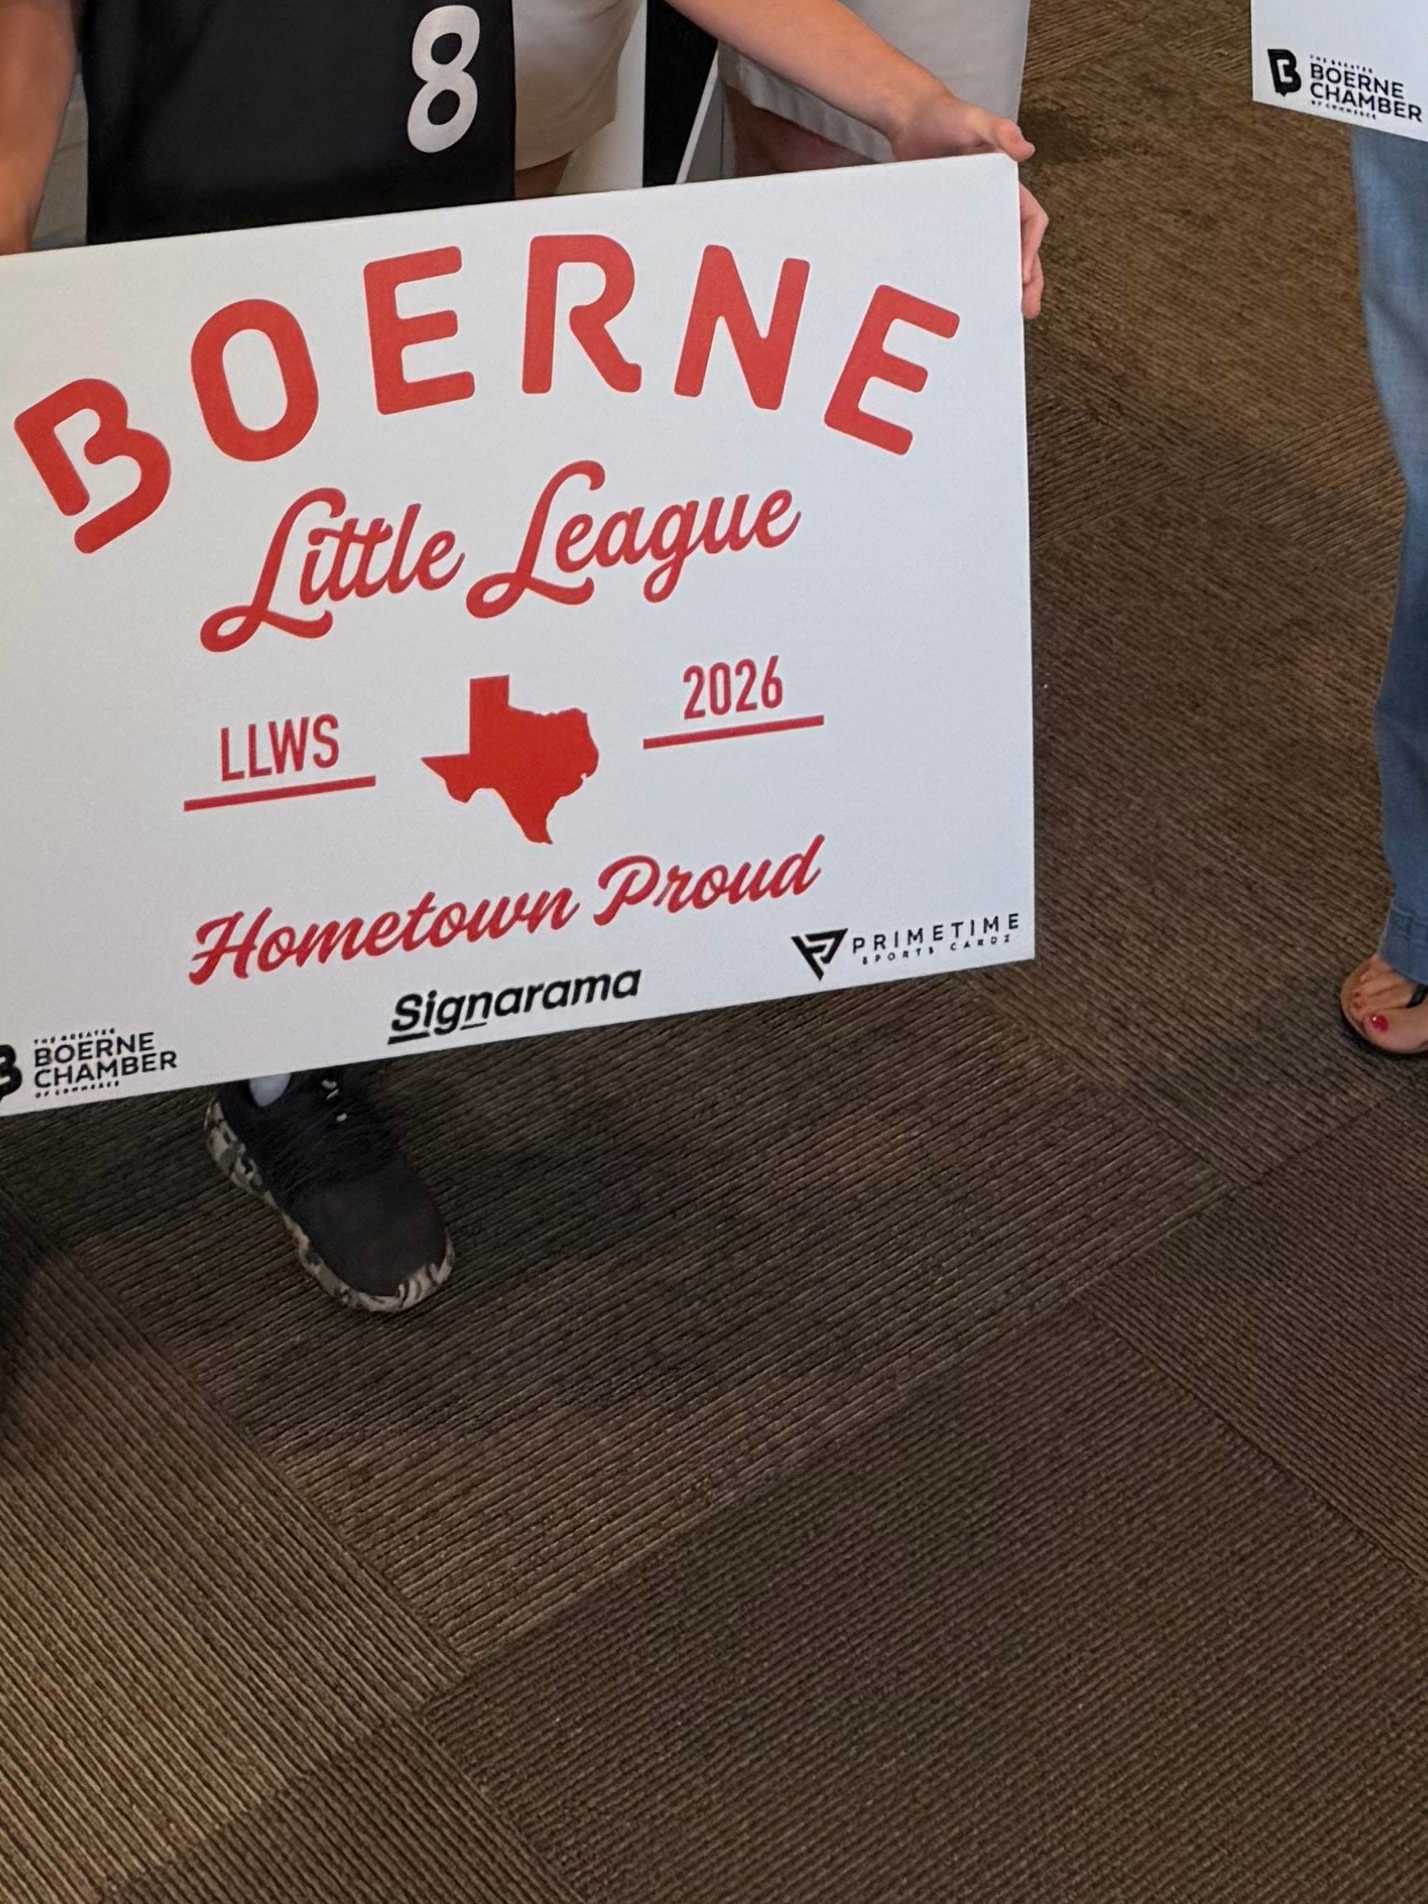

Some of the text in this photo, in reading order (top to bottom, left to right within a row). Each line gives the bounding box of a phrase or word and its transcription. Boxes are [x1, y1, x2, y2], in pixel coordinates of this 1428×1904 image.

[407, 4, 480, 154] 8
[1310, 82, 1422, 123] CHAMBER
[1311, 63, 1404, 100] BOERNE
[14, 235, 959, 554] BOERNE
[200, 461, 796, 653] Little League
[682, 653, 784, 721] 2026
[218, 711, 340, 784] LLWS
[189, 837, 823, 985] Hometown Proud
[853, 913, 1019, 954] PRIMETIME
[862, 947, 934, 965] SPORTS
[390, 969, 642, 1040] Signarama
[34, 1032, 154, 1067] BOERNE
[34, 1051, 177, 1088] CHAMBER
